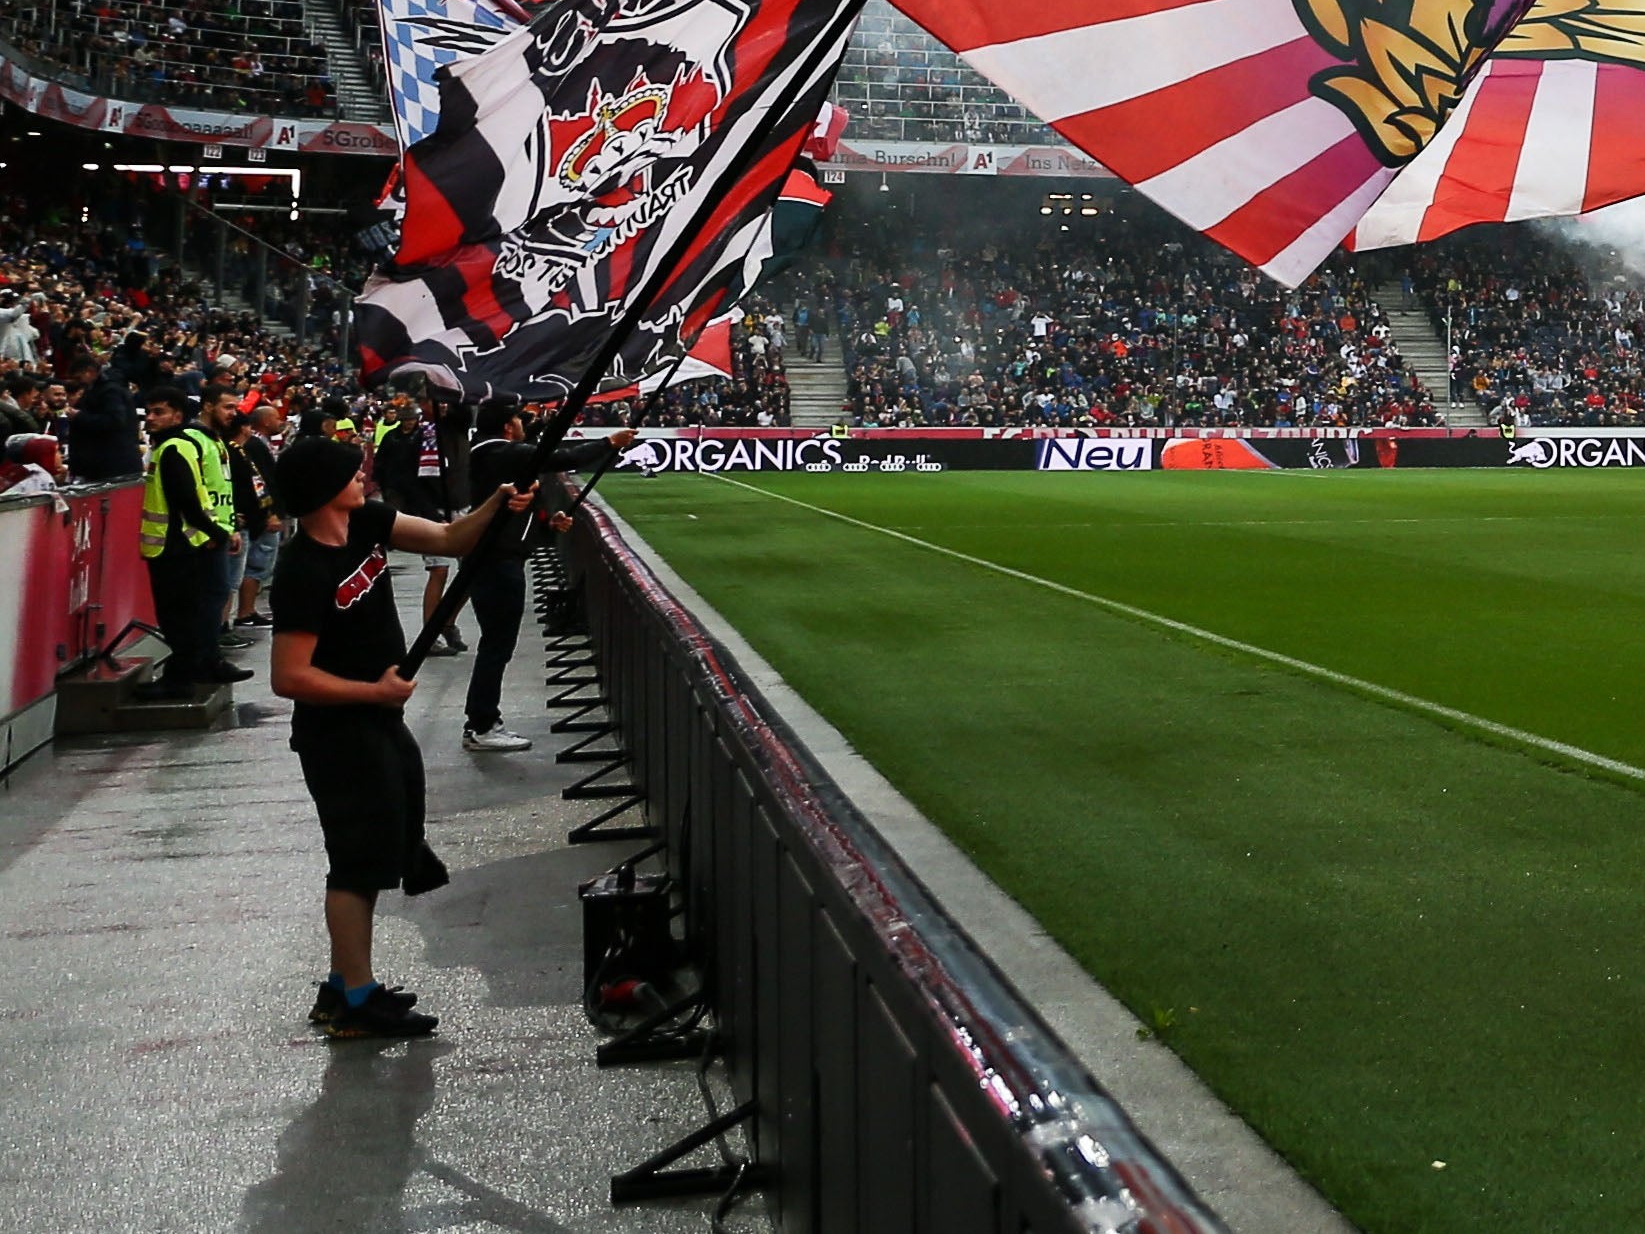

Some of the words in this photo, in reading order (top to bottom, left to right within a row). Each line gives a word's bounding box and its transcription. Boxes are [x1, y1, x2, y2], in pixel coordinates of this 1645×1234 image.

[277, 126, 296, 146] A1
[973, 152, 993, 170] A1
[645, 439, 842, 472] ORGANICS
[1043, 438, 1145, 469] Neu
